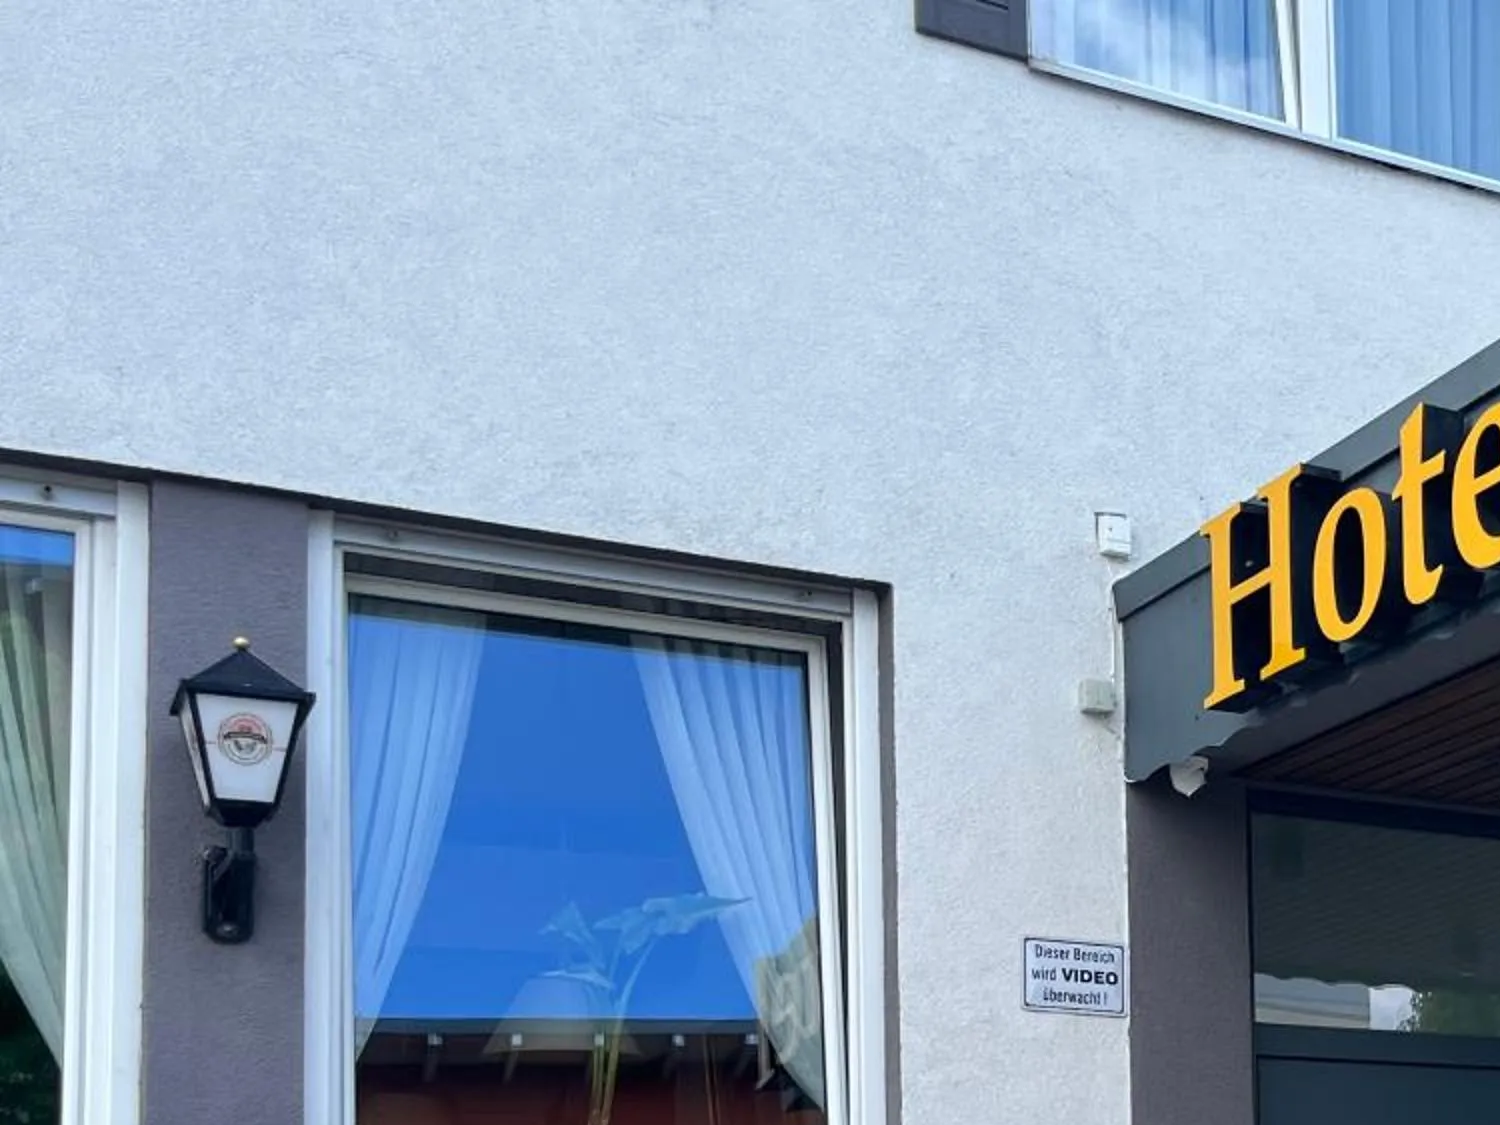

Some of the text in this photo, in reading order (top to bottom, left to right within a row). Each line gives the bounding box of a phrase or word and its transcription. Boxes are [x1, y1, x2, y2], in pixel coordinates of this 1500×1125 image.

[1034, 944, 1115, 964] Dieser Bereich
[1031, 966, 1118, 985] wird VIDEO
